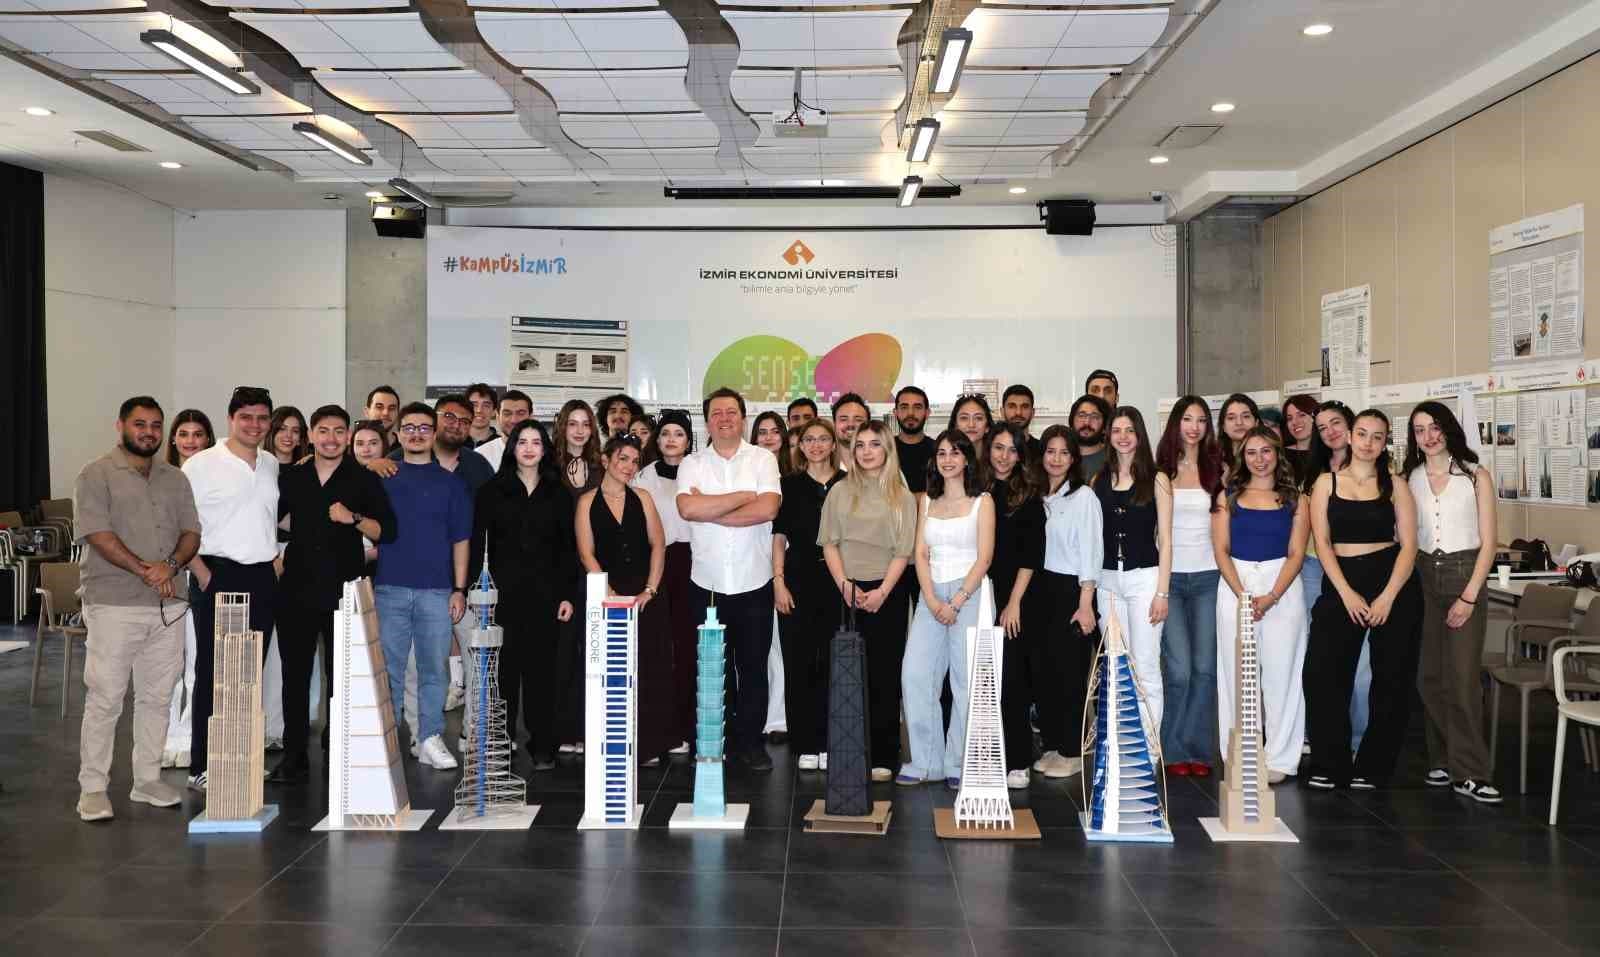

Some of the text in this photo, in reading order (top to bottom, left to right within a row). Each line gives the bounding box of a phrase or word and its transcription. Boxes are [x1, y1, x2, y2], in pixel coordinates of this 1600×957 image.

[699, 268, 898, 279] İZMİR EKONOMİ ÜNİVERSİTESİ
